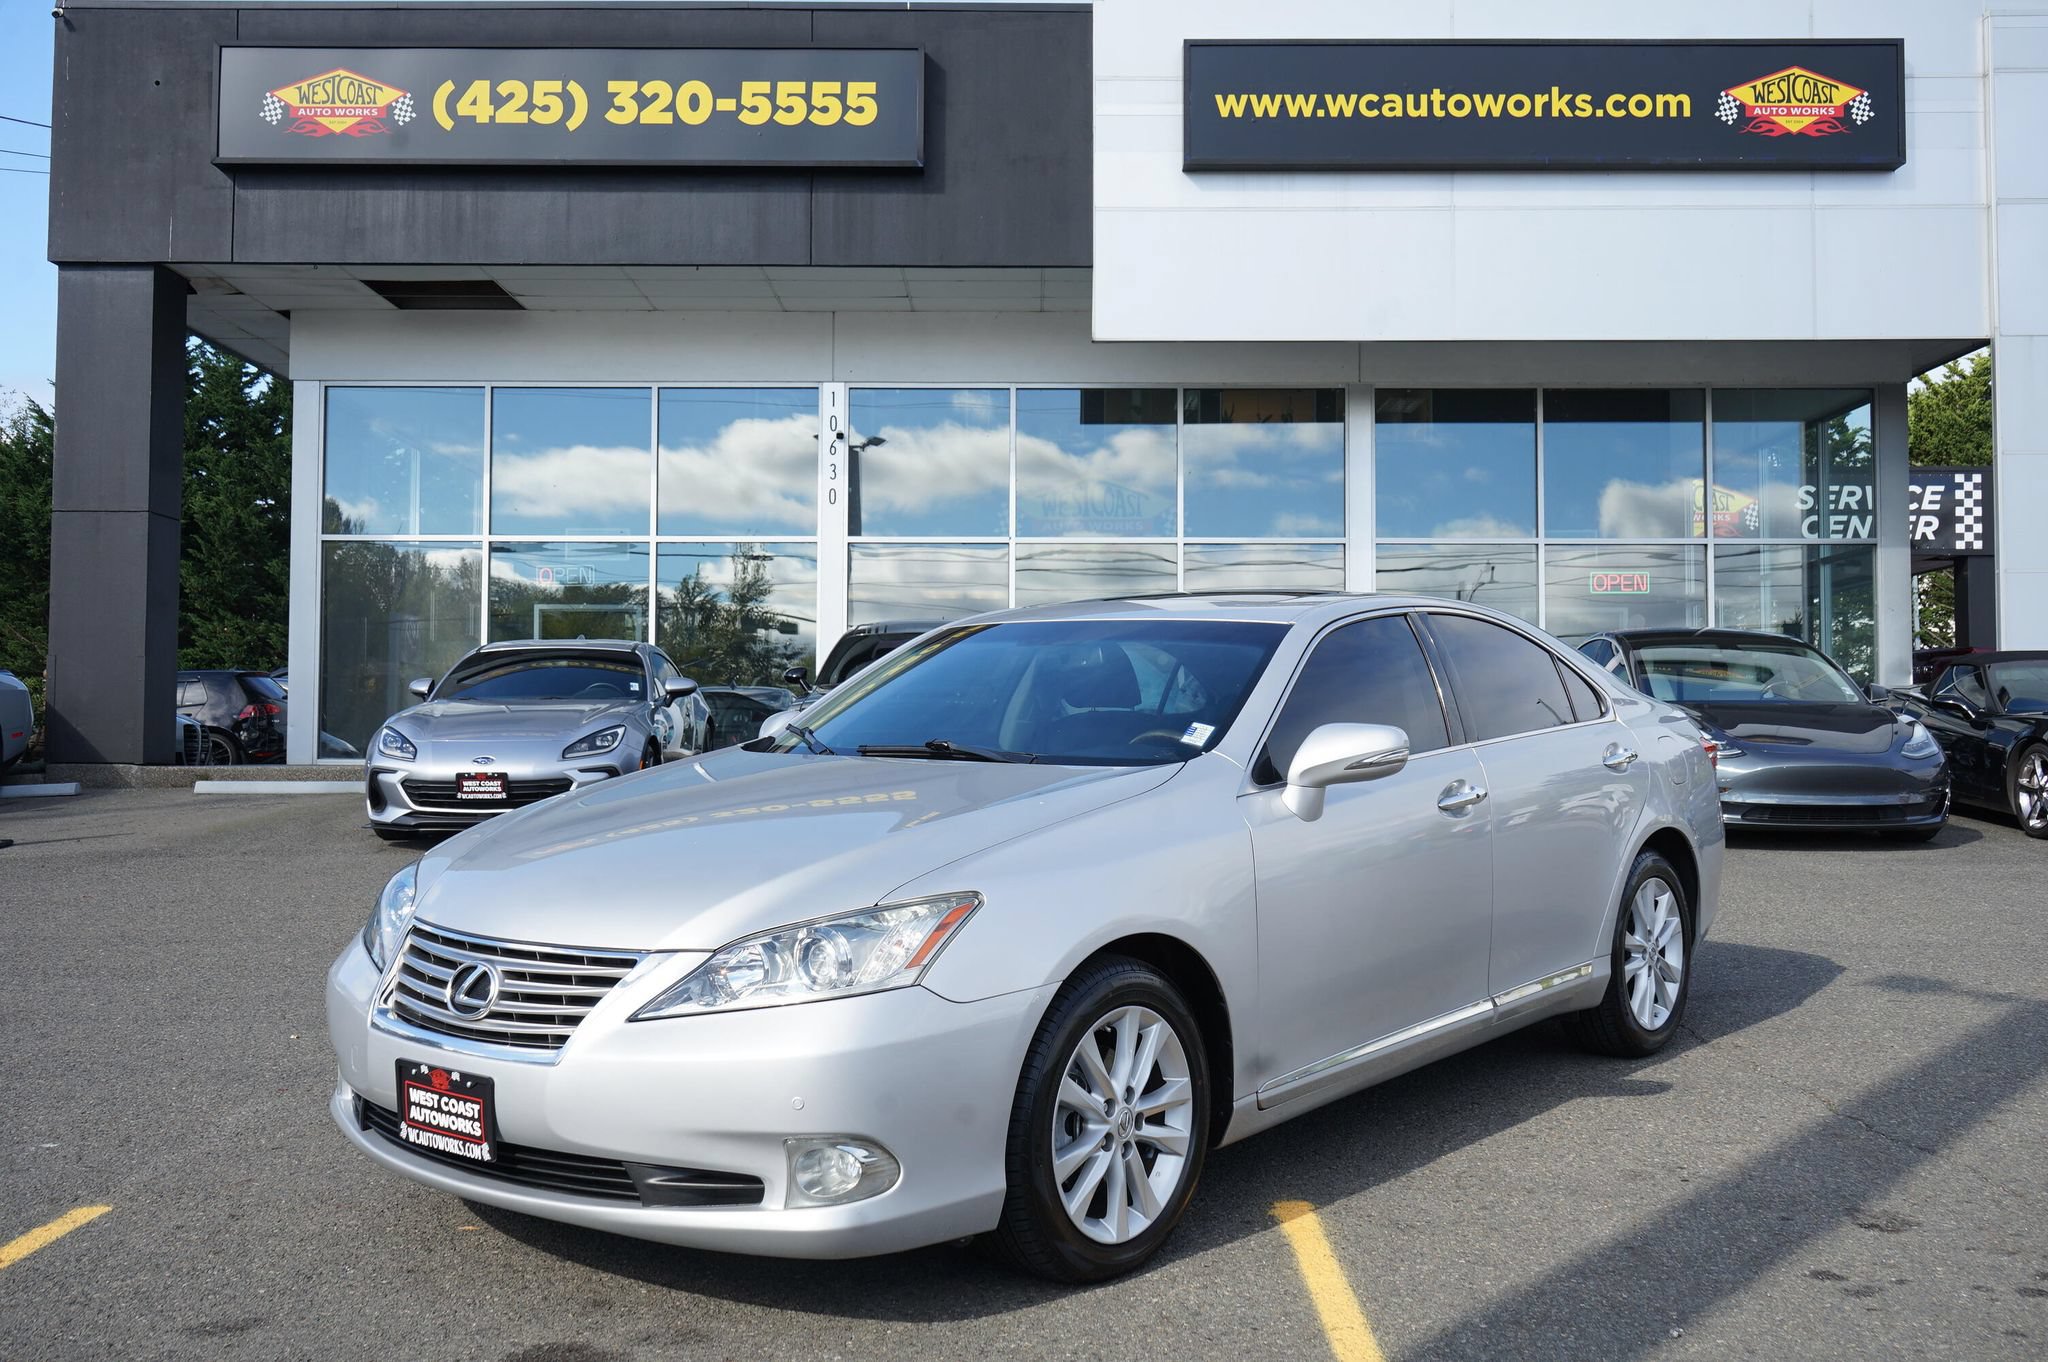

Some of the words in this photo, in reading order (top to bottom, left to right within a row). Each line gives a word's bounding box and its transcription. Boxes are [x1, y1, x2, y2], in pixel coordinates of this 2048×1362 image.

[298, 107, 332, 116] AUTO
[334, 107, 378, 116] WORKS
[432, 79, 588, 132] (425)
[604, 79, 878, 127] 320-5555
[1215, 86, 1692, 118] www.wcautoworks.com
[1753, 106, 1788, 116] AUTO
[1790, 106, 1835, 116] WORKS
[828, 391, 838, 505] 10630
[540, 567, 592, 584] OPEN
[1593, 574, 1647, 591] OPEN
[409, 1087, 439, 1109] WEST
[440, 1096, 480, 1119] COAST
[409, 1105, 482, 1137] AUTOWORKS
[407, 1127, 482, 1160] WCAUTOWORKS.COM
